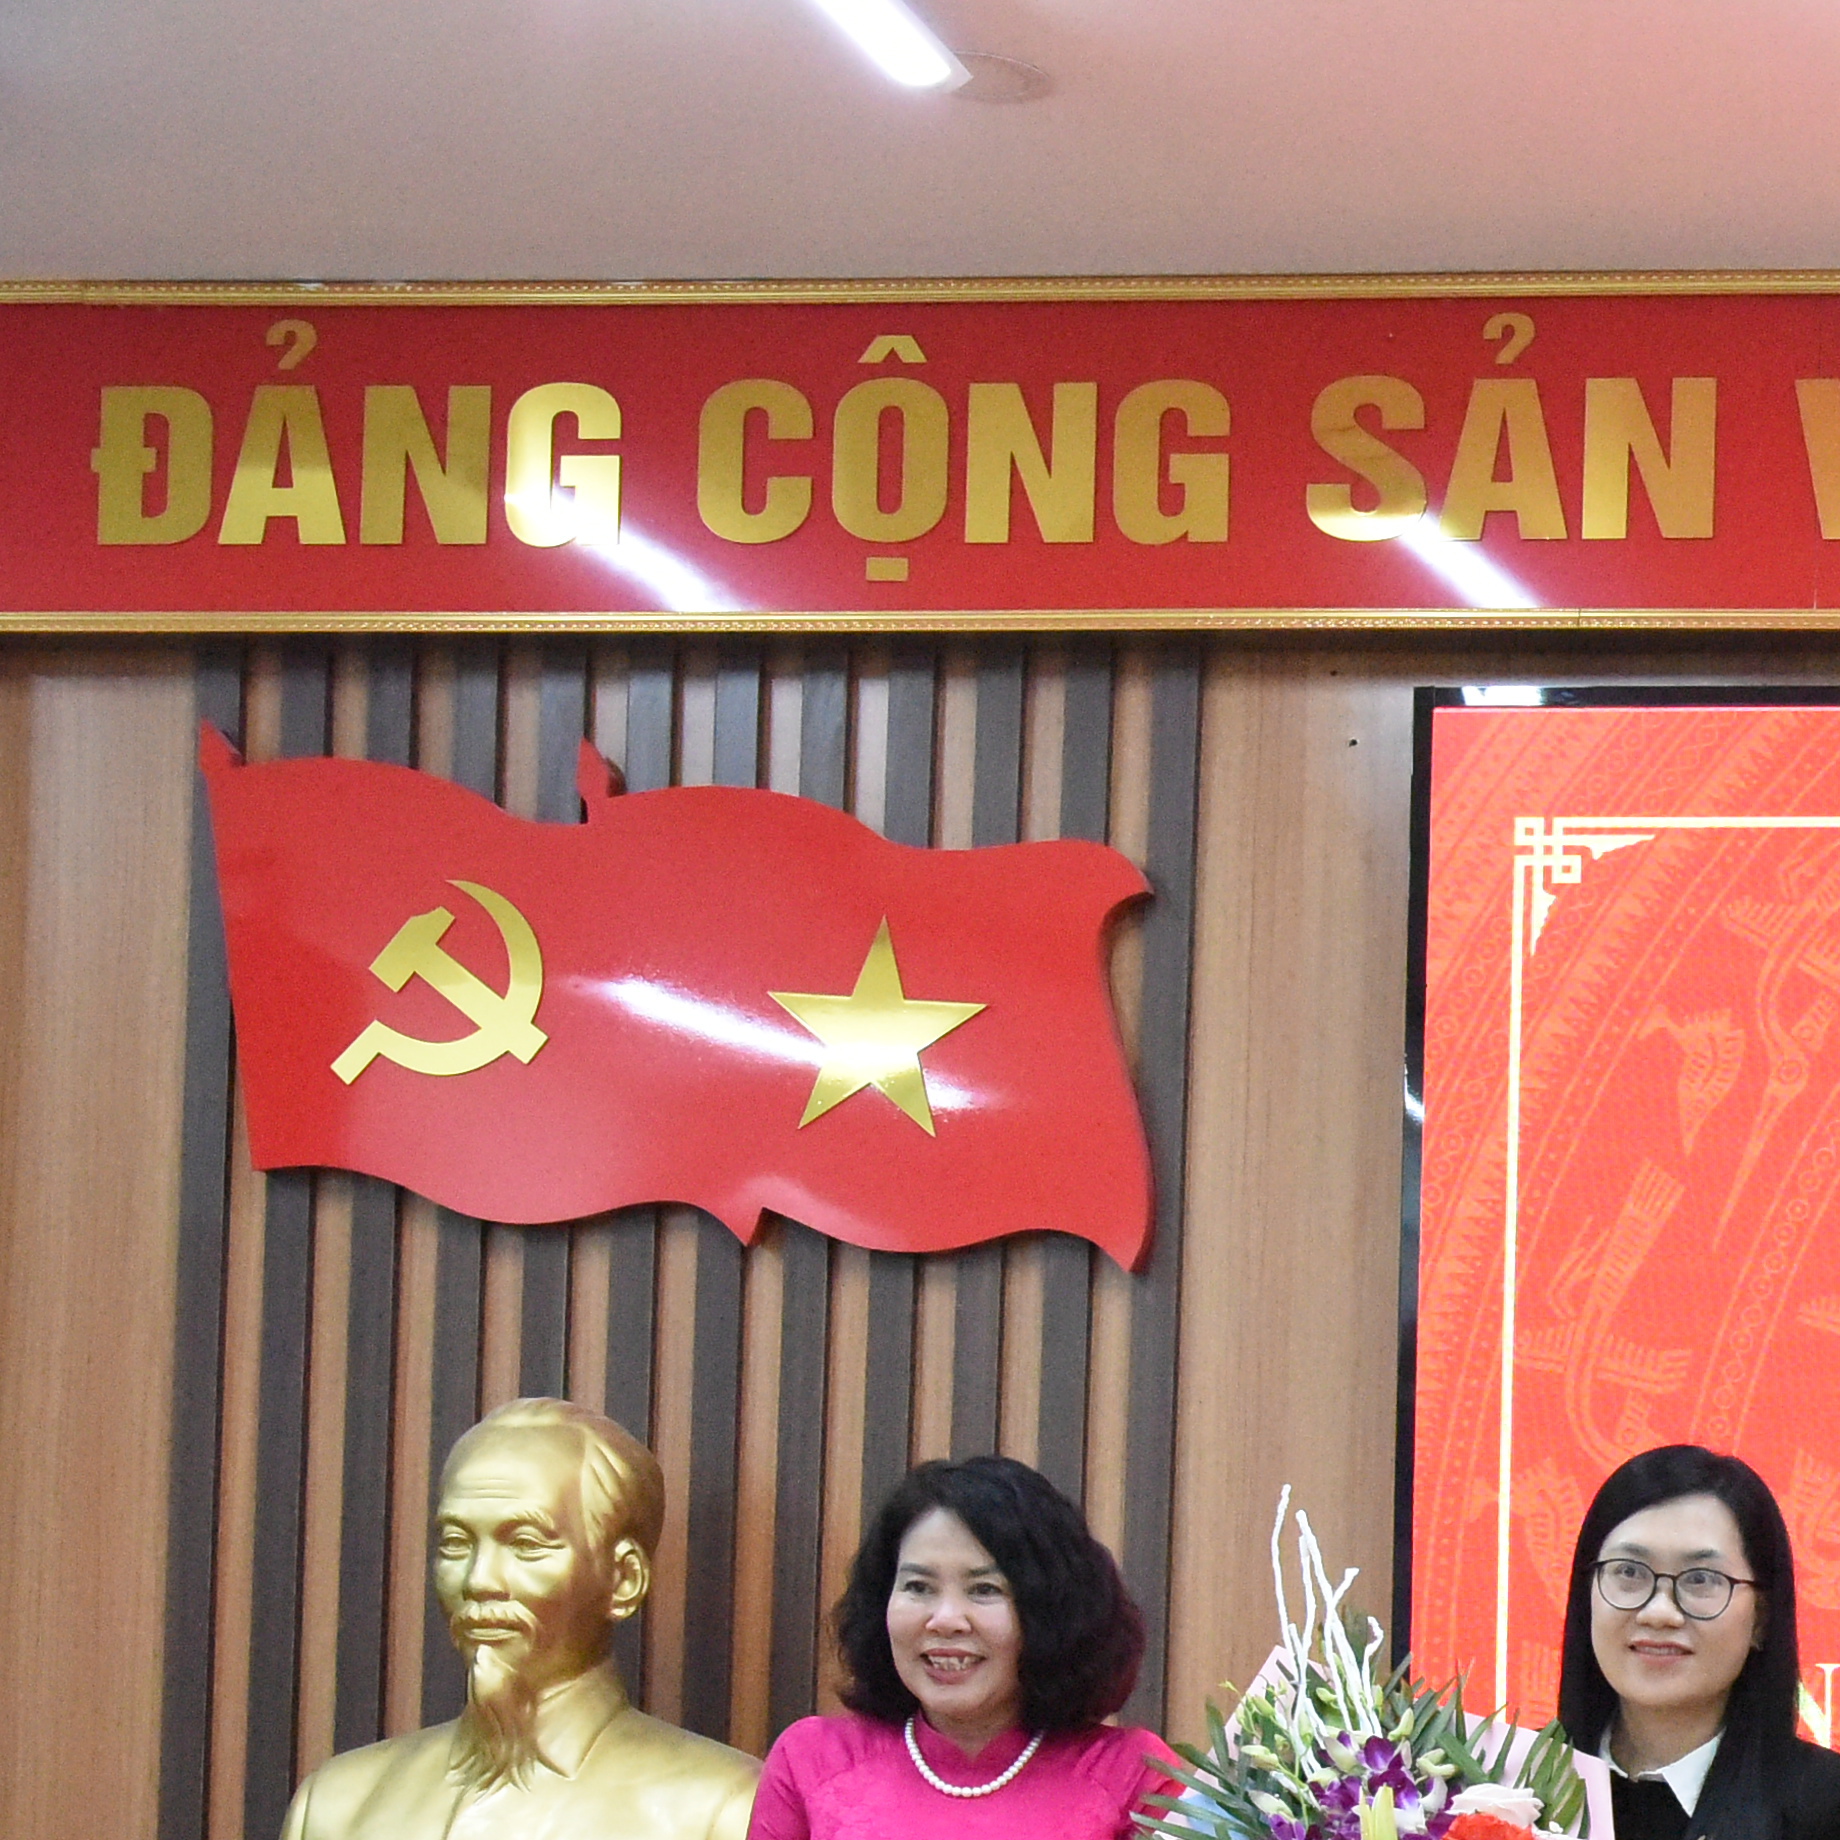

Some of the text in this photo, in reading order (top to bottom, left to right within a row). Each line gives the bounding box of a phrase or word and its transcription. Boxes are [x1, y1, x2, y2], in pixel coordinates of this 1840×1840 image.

[91, 320, 623, 548] ĐẢNG
[697, 335, 1232, 583] CỘNG
[1306, 312, 1717, 542] SẢN
